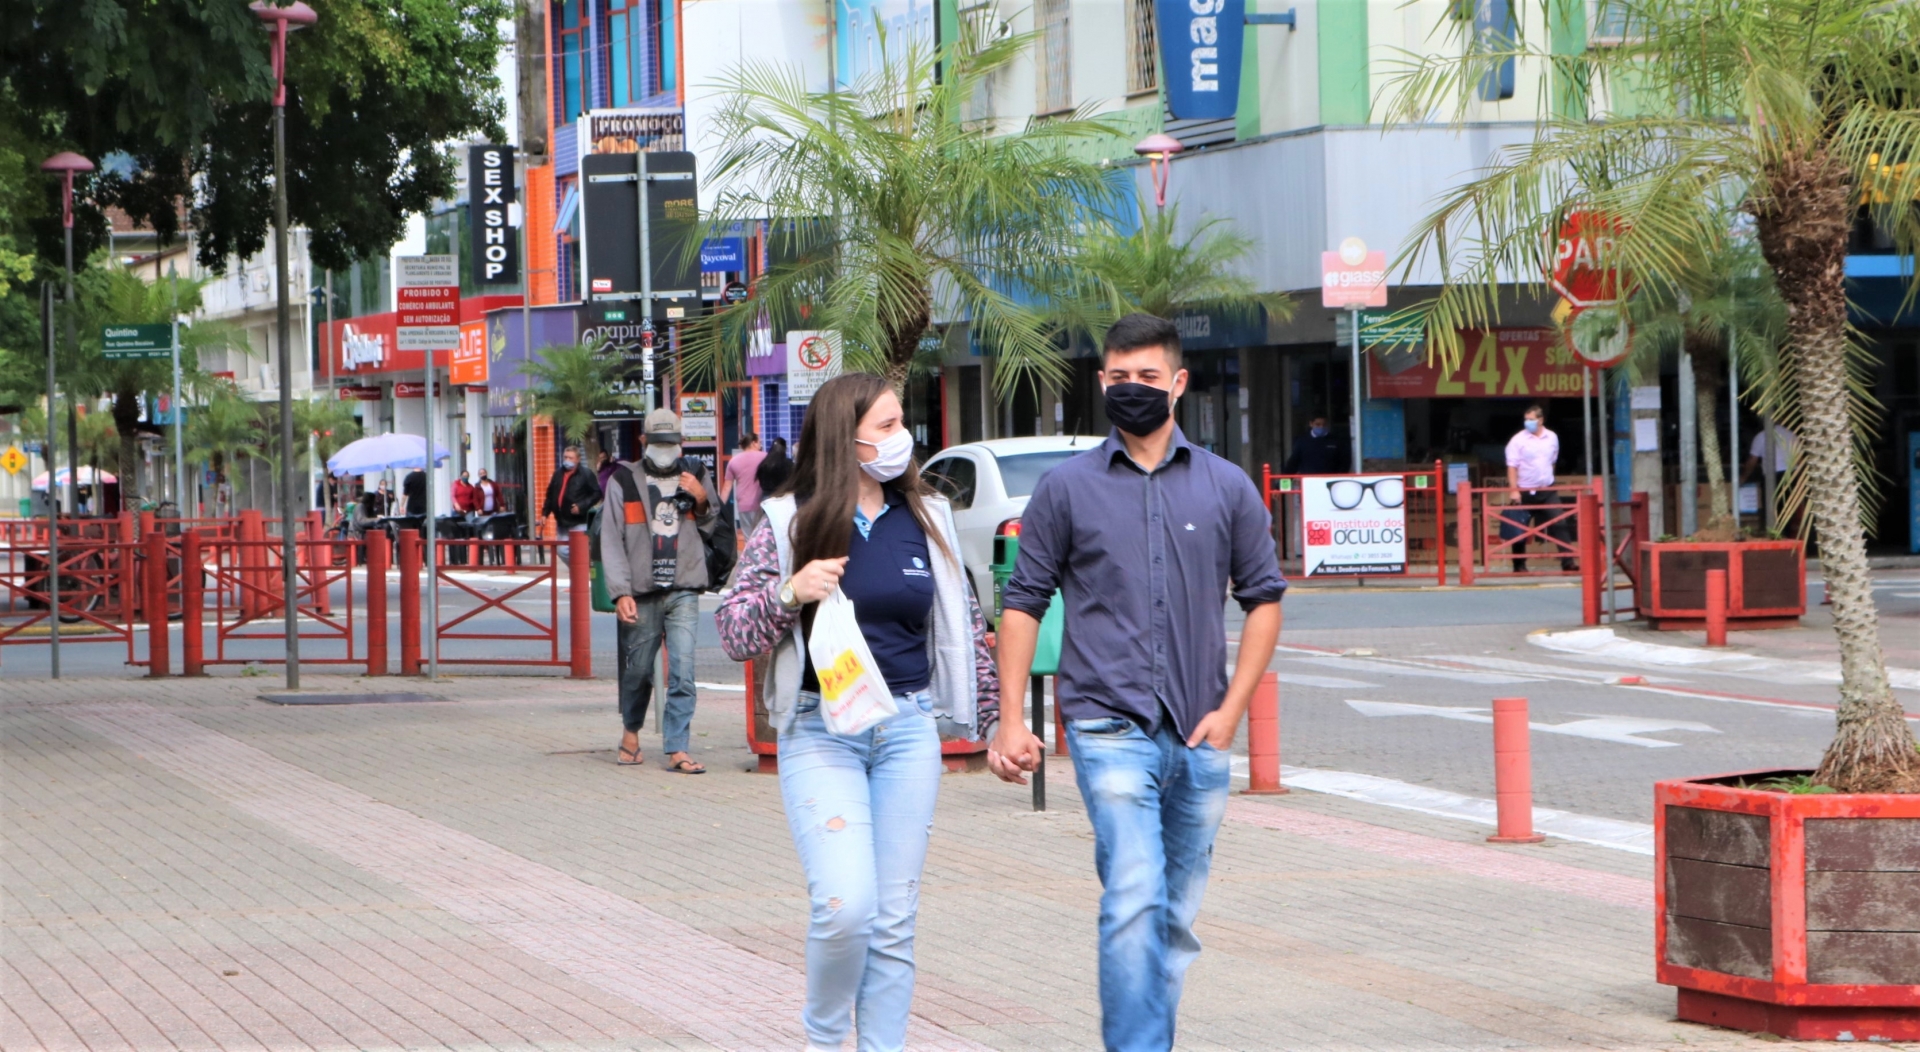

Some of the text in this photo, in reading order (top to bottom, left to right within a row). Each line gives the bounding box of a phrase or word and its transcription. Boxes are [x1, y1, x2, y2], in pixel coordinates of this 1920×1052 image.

[483, 151, 507, 279] SEX SHOP
[701, 253, 736, 264] Daycoval
[1554, 236, 1626, 270] PAR
[403, 288, 450, 297] PROIBIDO O
[398, 301, 455, 310] COMÉRCIO AMBULANTE
[403, 314, 451, 324] SEM AUTORIZAÇÃO
[105, 328, 138, 338] Quintino
[597, 321, 657, 344] papirs
[1499, 331, 1540, 342] OFERTAS
[1333, 517, 1404, 529] Instituto dos
[1334, 527, 1403, 545] ÓCULOS
